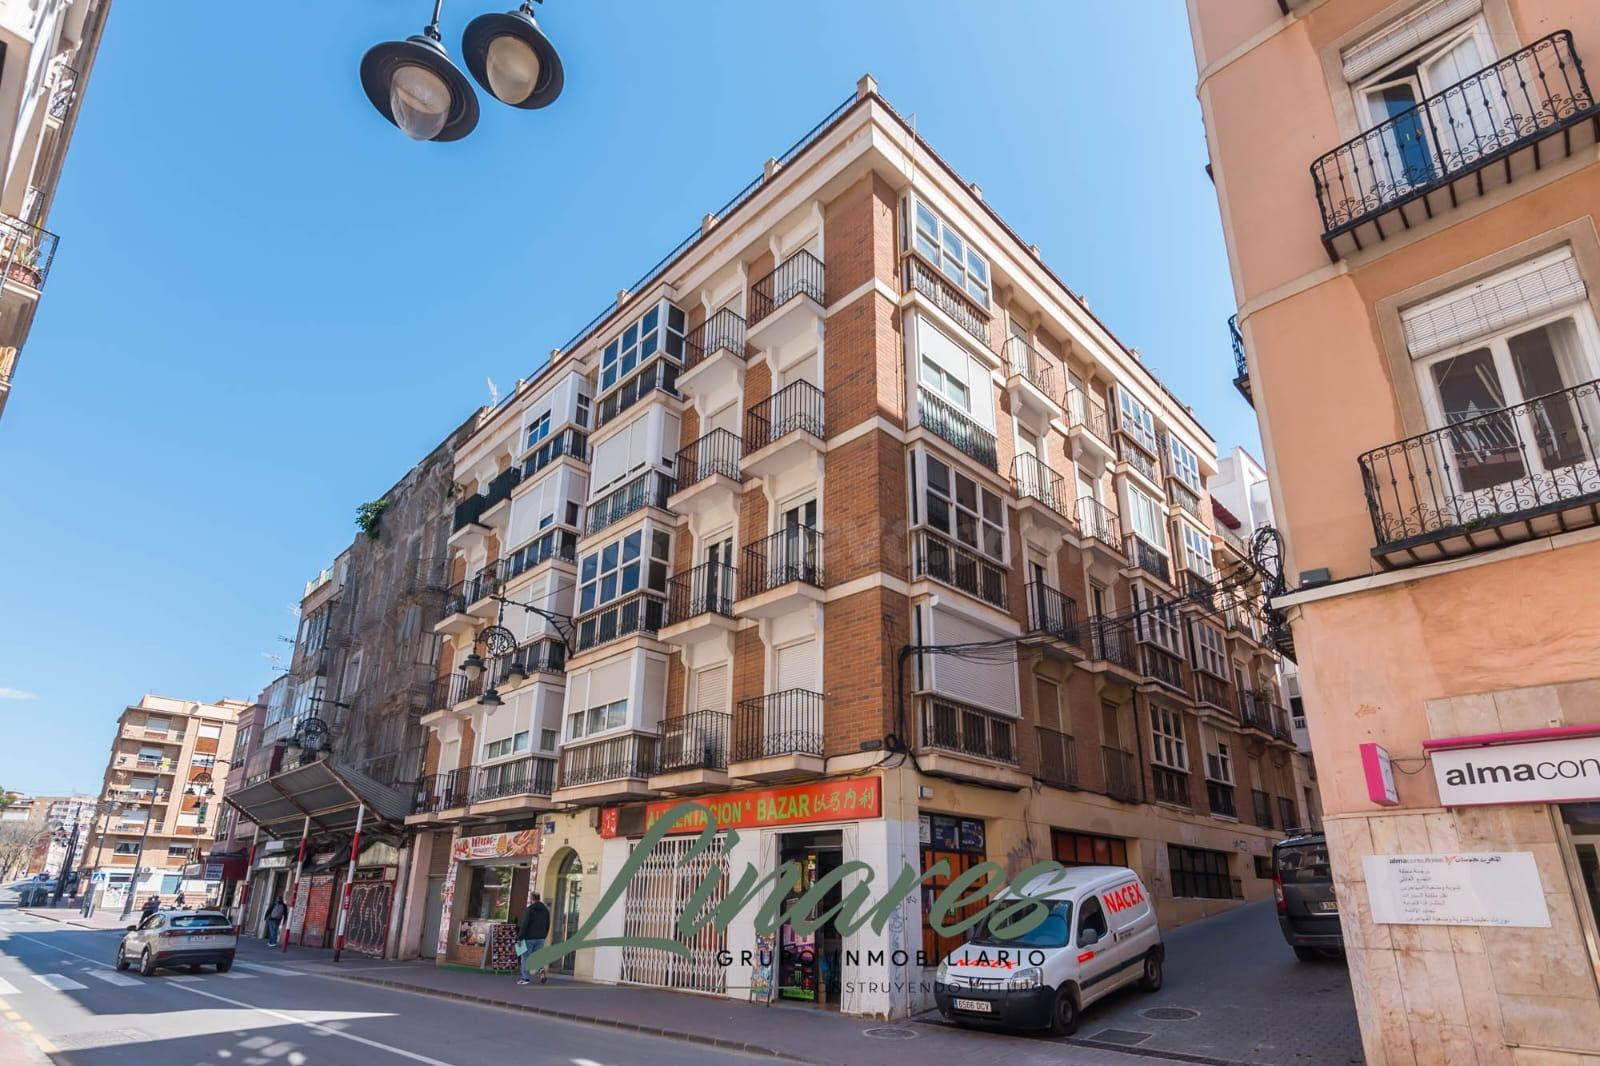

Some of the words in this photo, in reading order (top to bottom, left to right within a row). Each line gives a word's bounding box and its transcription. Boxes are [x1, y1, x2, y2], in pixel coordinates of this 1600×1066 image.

[646, 801, 742, 833] ALENTACION
[756, 794, 811, 822] BAZAR
[1102, 882, 1145, 914] NACEX
